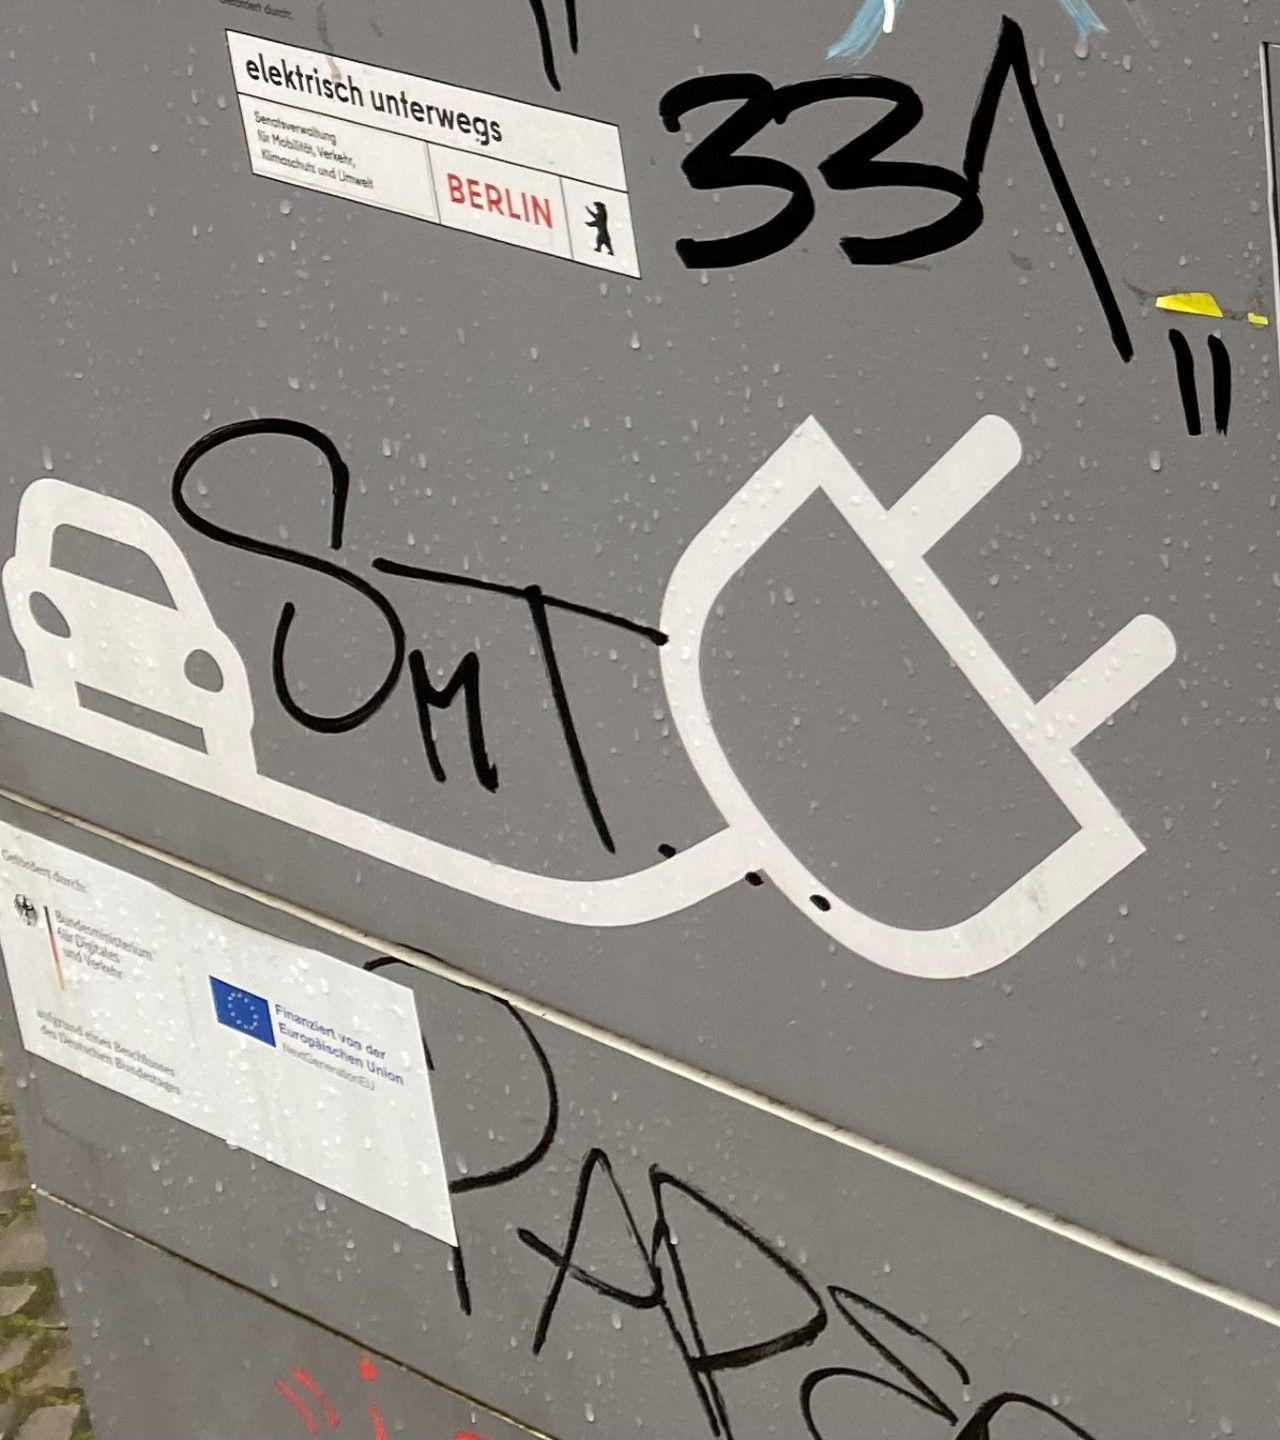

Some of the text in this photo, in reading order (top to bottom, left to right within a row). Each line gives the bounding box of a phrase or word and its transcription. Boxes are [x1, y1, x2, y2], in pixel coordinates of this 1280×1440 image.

[246, 53, 503, 146] elektrisch unterwegs
[318, 166, 336, 179] und
[447, 173, 554, 229] BERLIN
[275, 1004, 387, 1060] Finanziert von der
[278, 1022, 404, 1086] Europäischen Union
